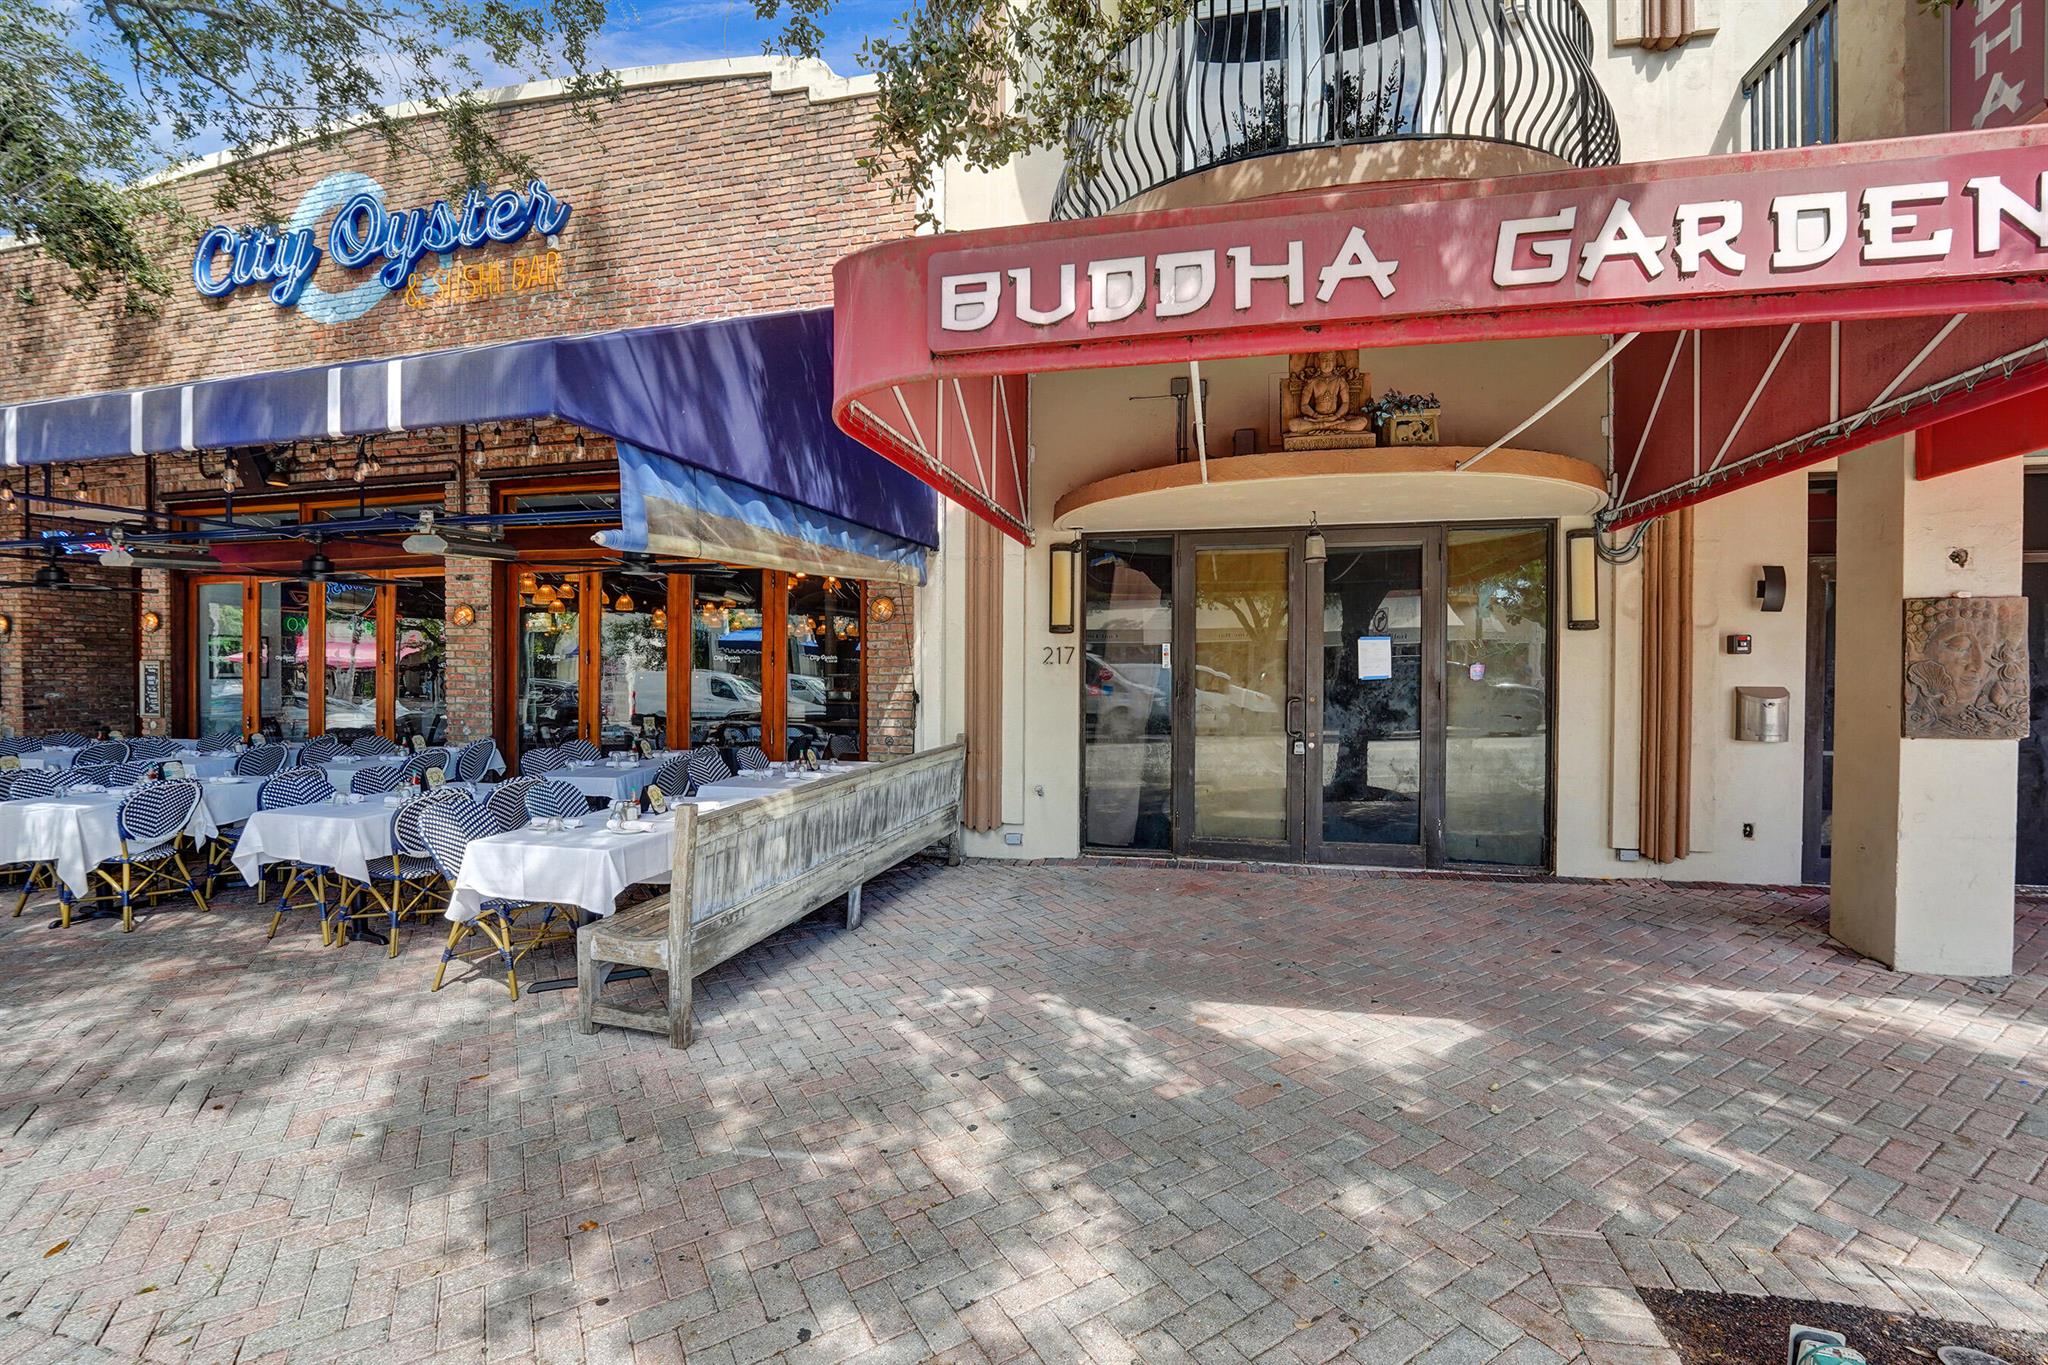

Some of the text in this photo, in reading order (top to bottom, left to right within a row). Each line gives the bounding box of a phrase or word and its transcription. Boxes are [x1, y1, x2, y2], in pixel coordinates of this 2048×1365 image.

[193, 178, 573, 307] City Oyster
[405, 250, 563, 308] & SUSHI BAR
[940, 175, 2048, 332] BUDDHA GARDEN
[1042, 646, 1075, 665] 217
